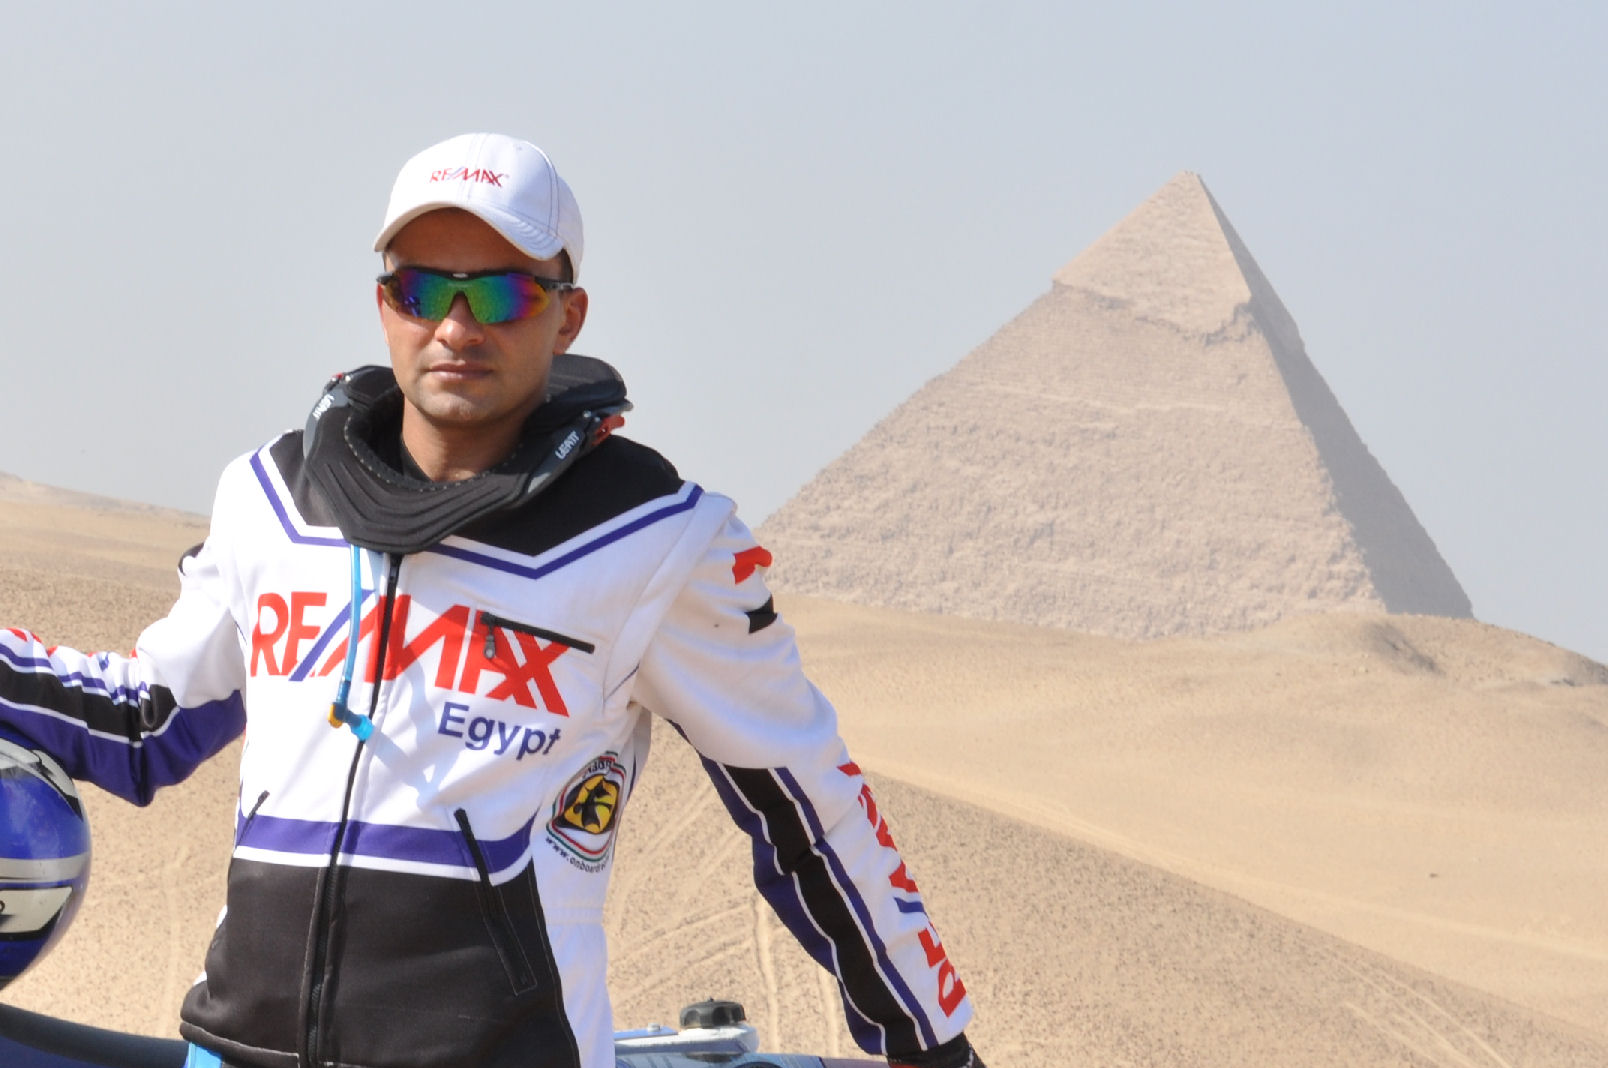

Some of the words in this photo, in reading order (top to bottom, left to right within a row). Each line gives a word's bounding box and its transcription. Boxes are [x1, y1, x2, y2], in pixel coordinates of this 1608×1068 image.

[429, 167, 504, 188] RE/MAX
[554, 429, 581, 461] LEATT
[250, 589, 571, 718] RE/MAX
[437, 701, 562, 760] Egypt
